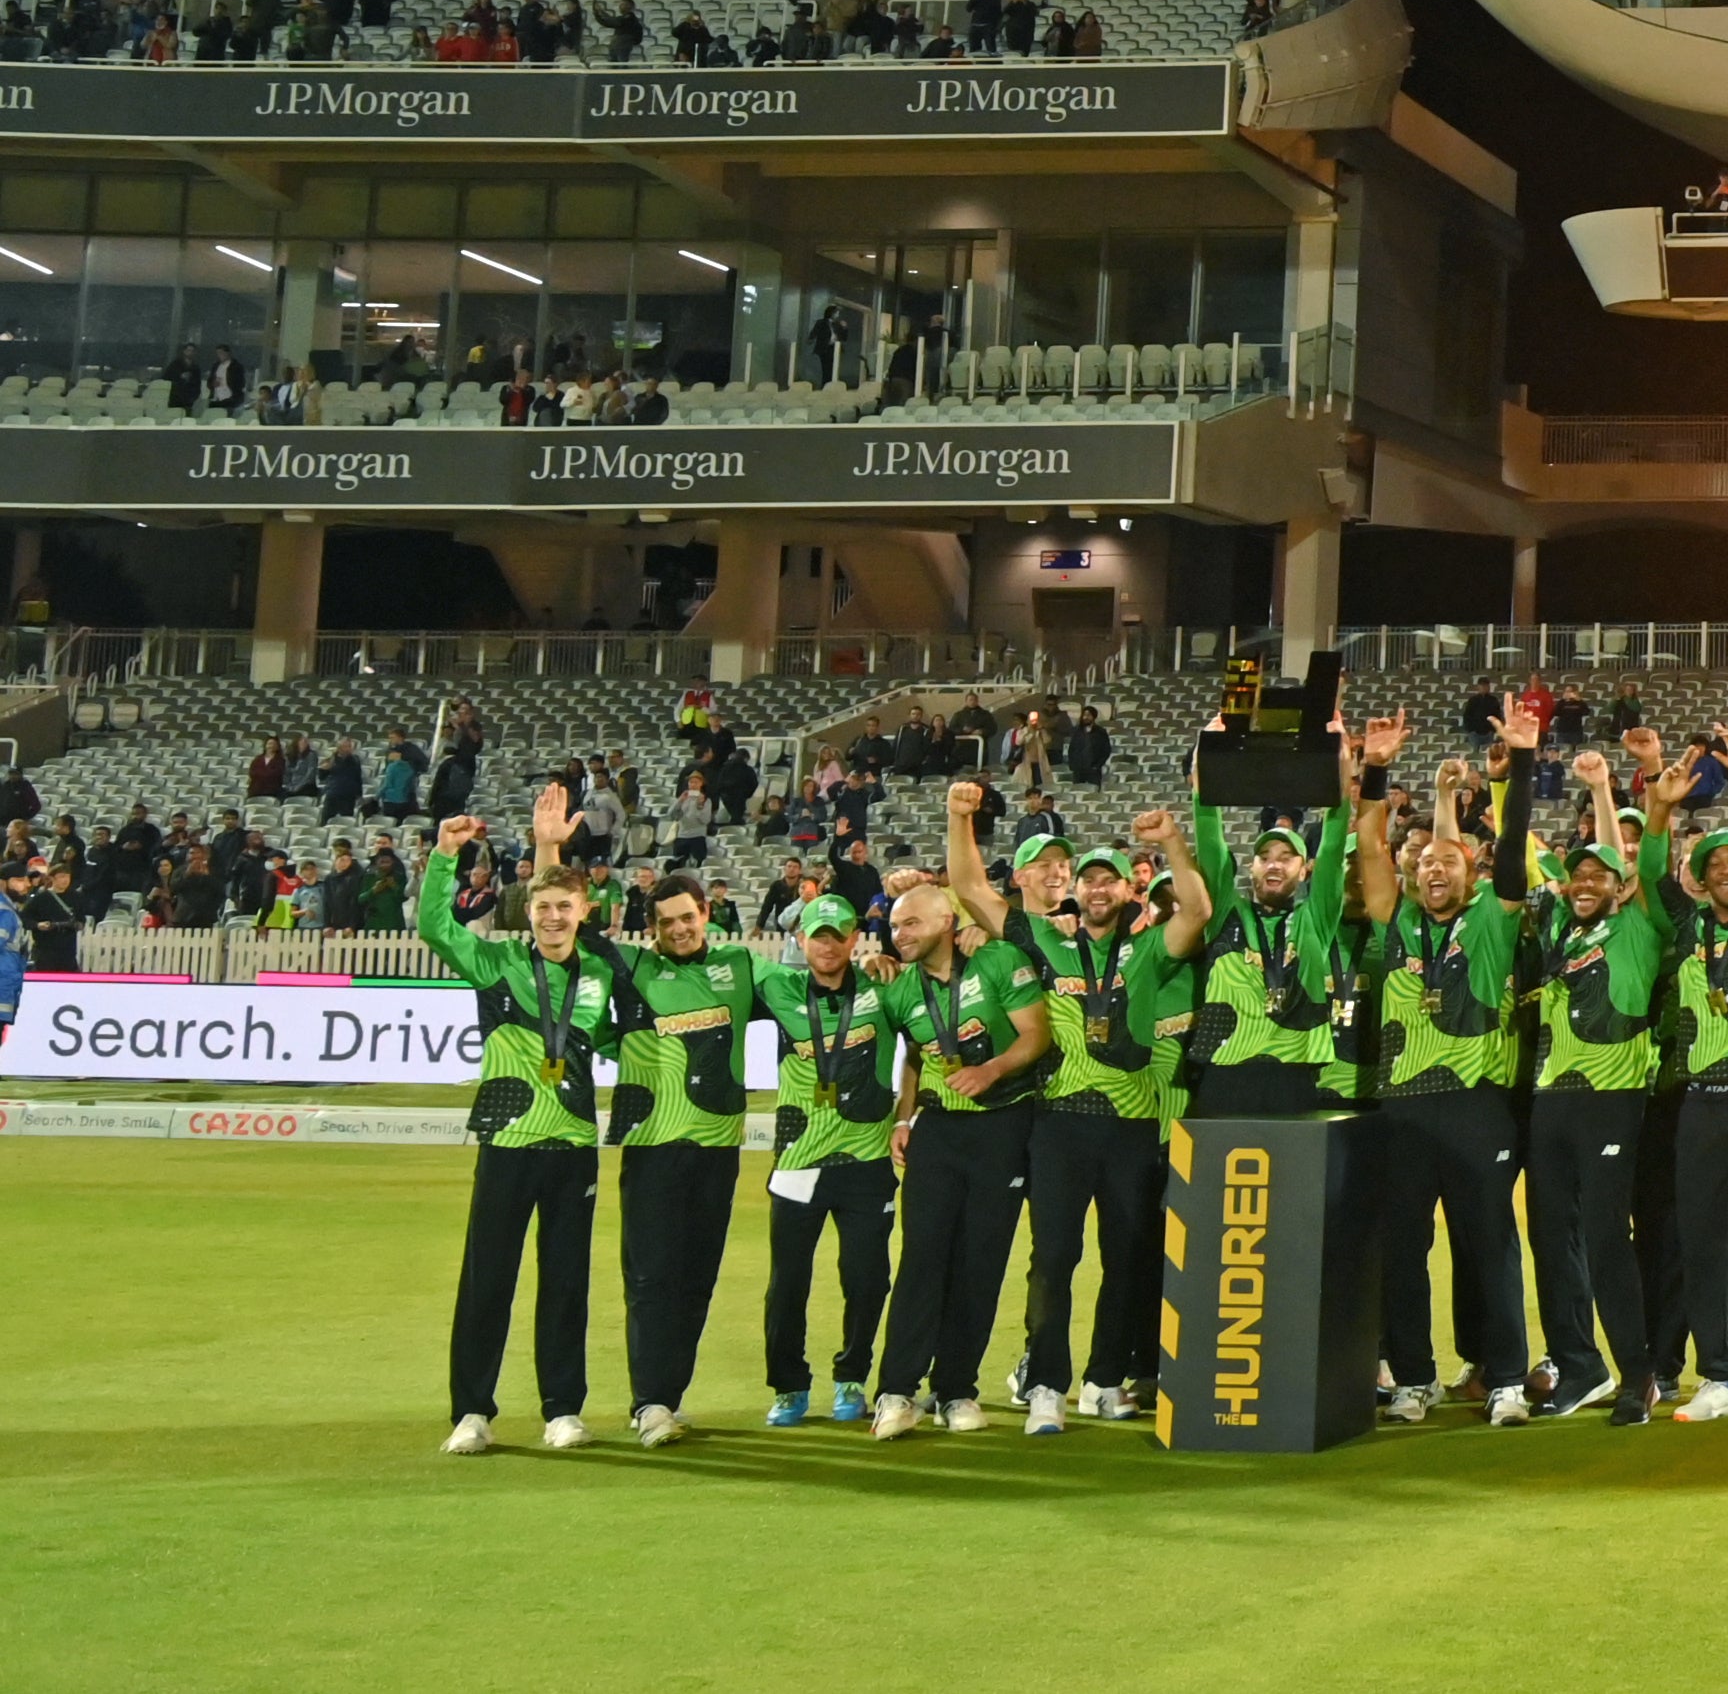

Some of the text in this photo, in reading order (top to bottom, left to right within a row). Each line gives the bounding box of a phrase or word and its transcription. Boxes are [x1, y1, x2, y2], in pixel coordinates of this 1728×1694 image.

[256, 83, 471, 127] J.P.Morgan
[591, 83, 799, 126] J.P.Morgan
[906, 80, 1117, 122] J.P.Morgan
[189, 444, 412, 491] J.P.Morgan
[530, 444, 745, 491] J.P.Morgan
[853, 441, 1071, 487] J.P.Morgan
[49, 1005, 292, 1061] Search.
[24, 1113, 164, 1129] Search. Drive. Smile.
[189, 1112, 297, 1137] CAZOO
[319, 1120, 465, 1136] Search. Drive. Smile.
[1214, 1148, 1270, 1426] HUNDRED
